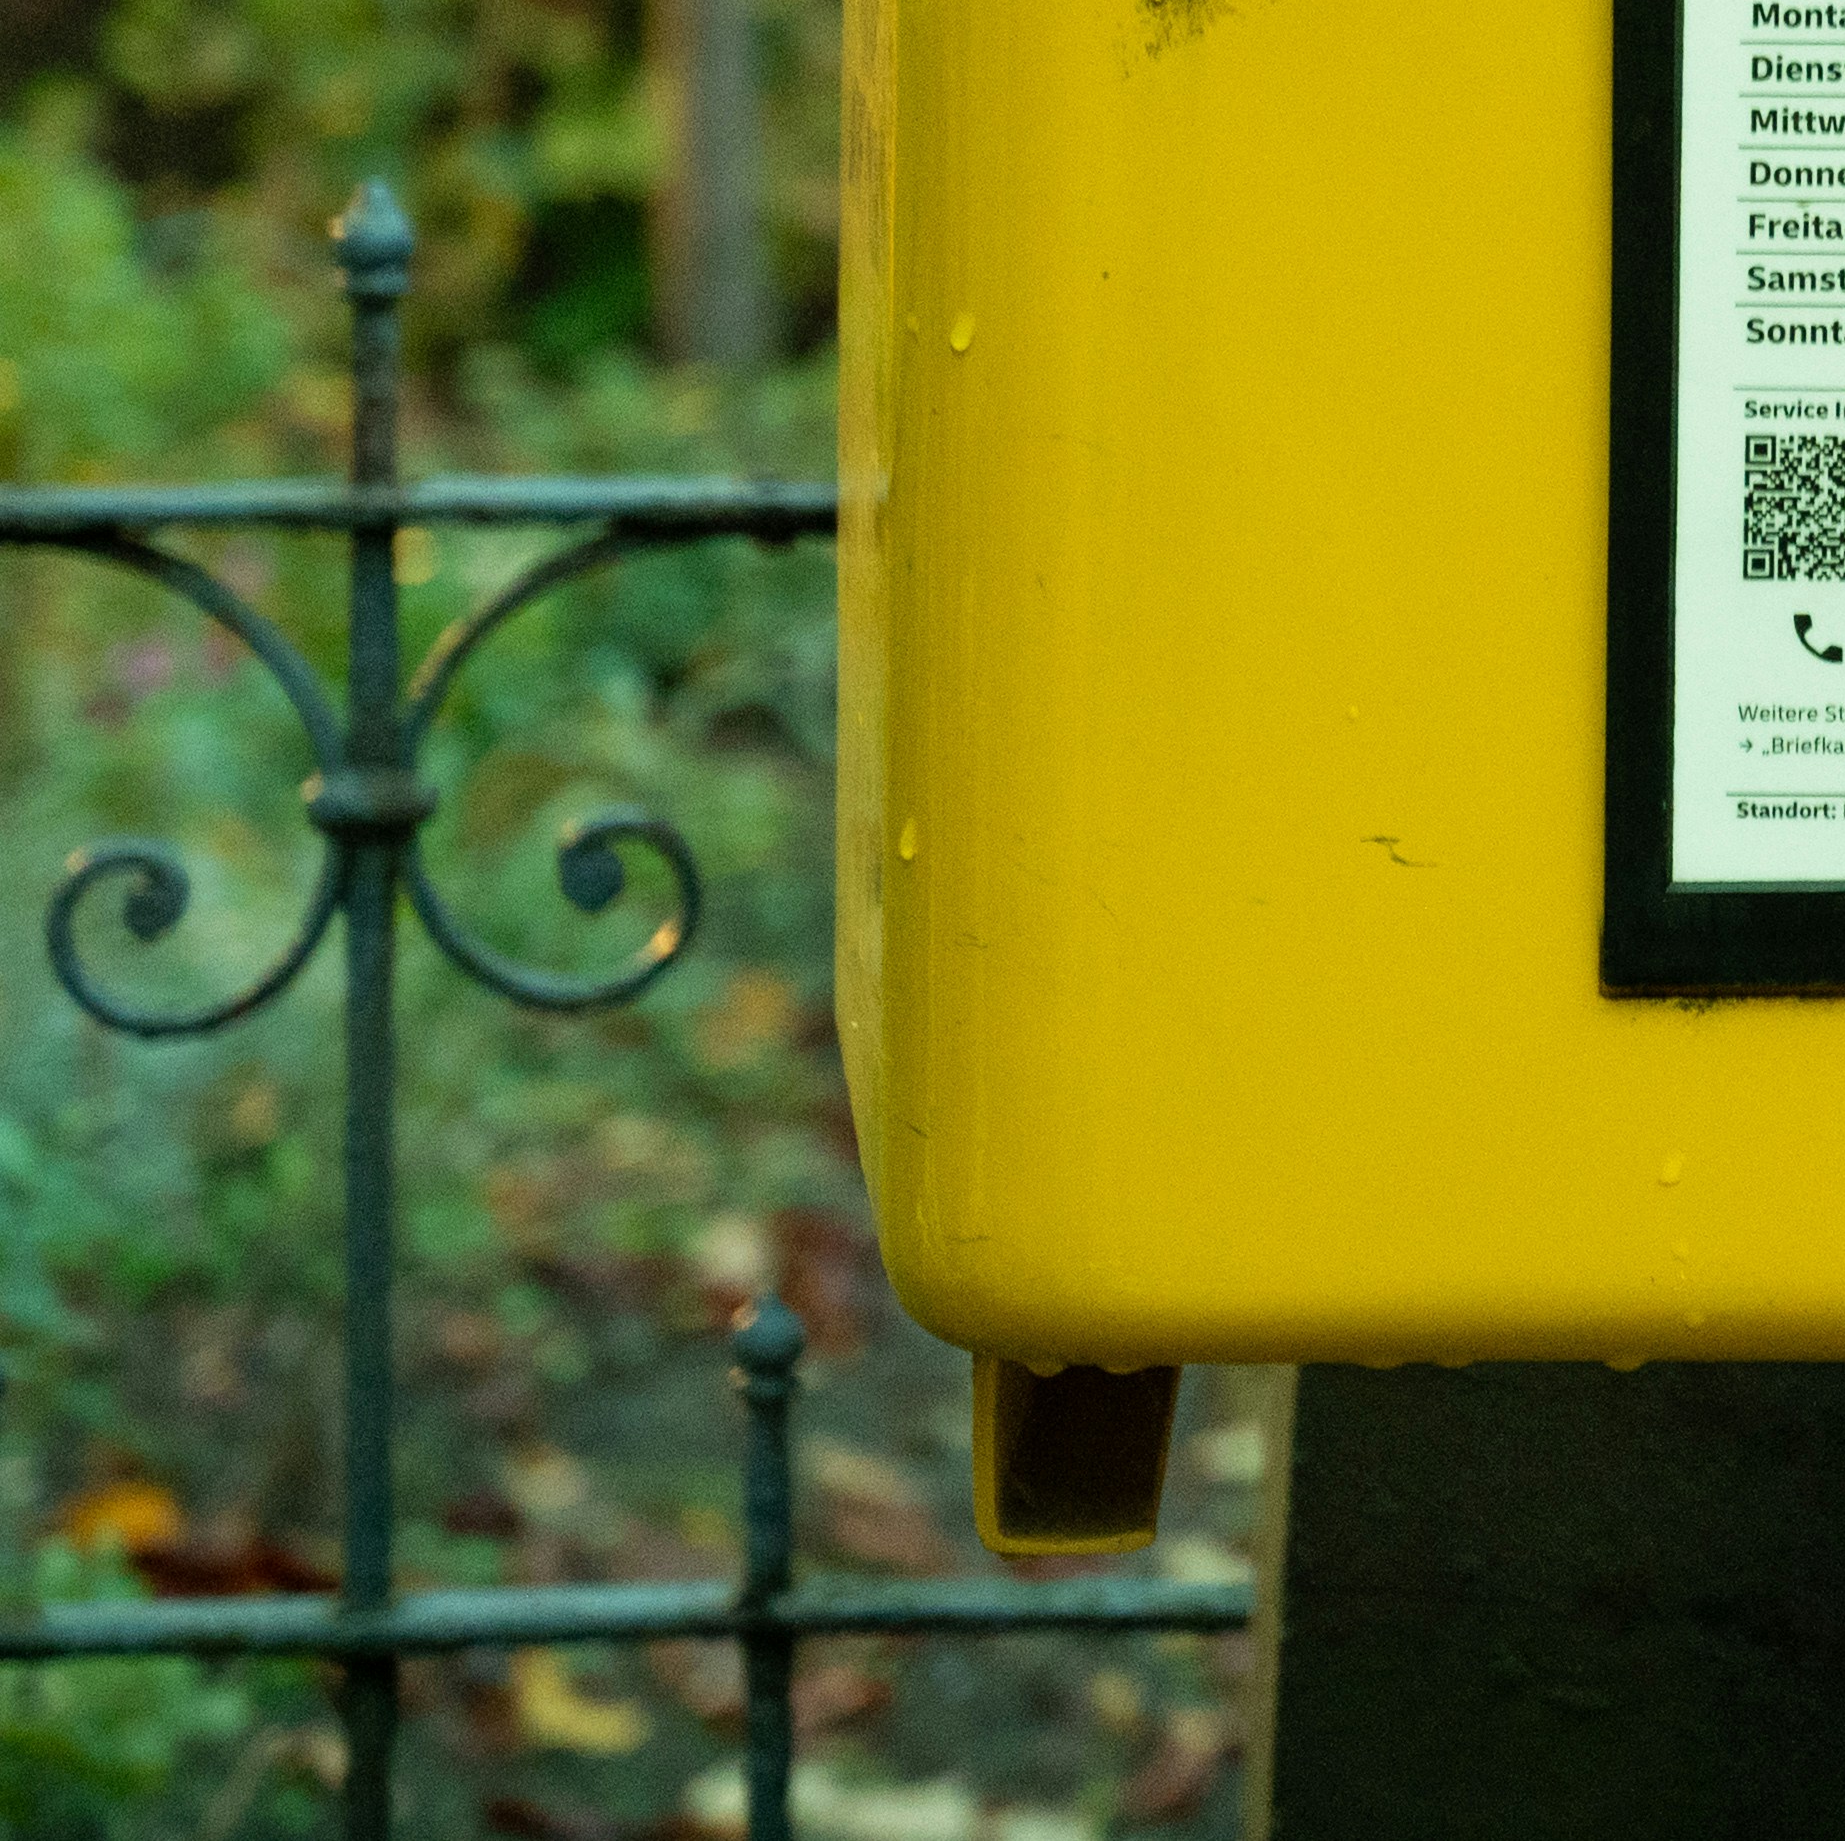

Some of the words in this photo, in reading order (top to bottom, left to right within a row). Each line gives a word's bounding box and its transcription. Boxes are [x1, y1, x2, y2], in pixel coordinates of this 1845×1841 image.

[1745, 399, 1829, 419] Service
[1738, 704, 1819, 723] Weitere
[1736, 801, 1837, 820] Standort:
